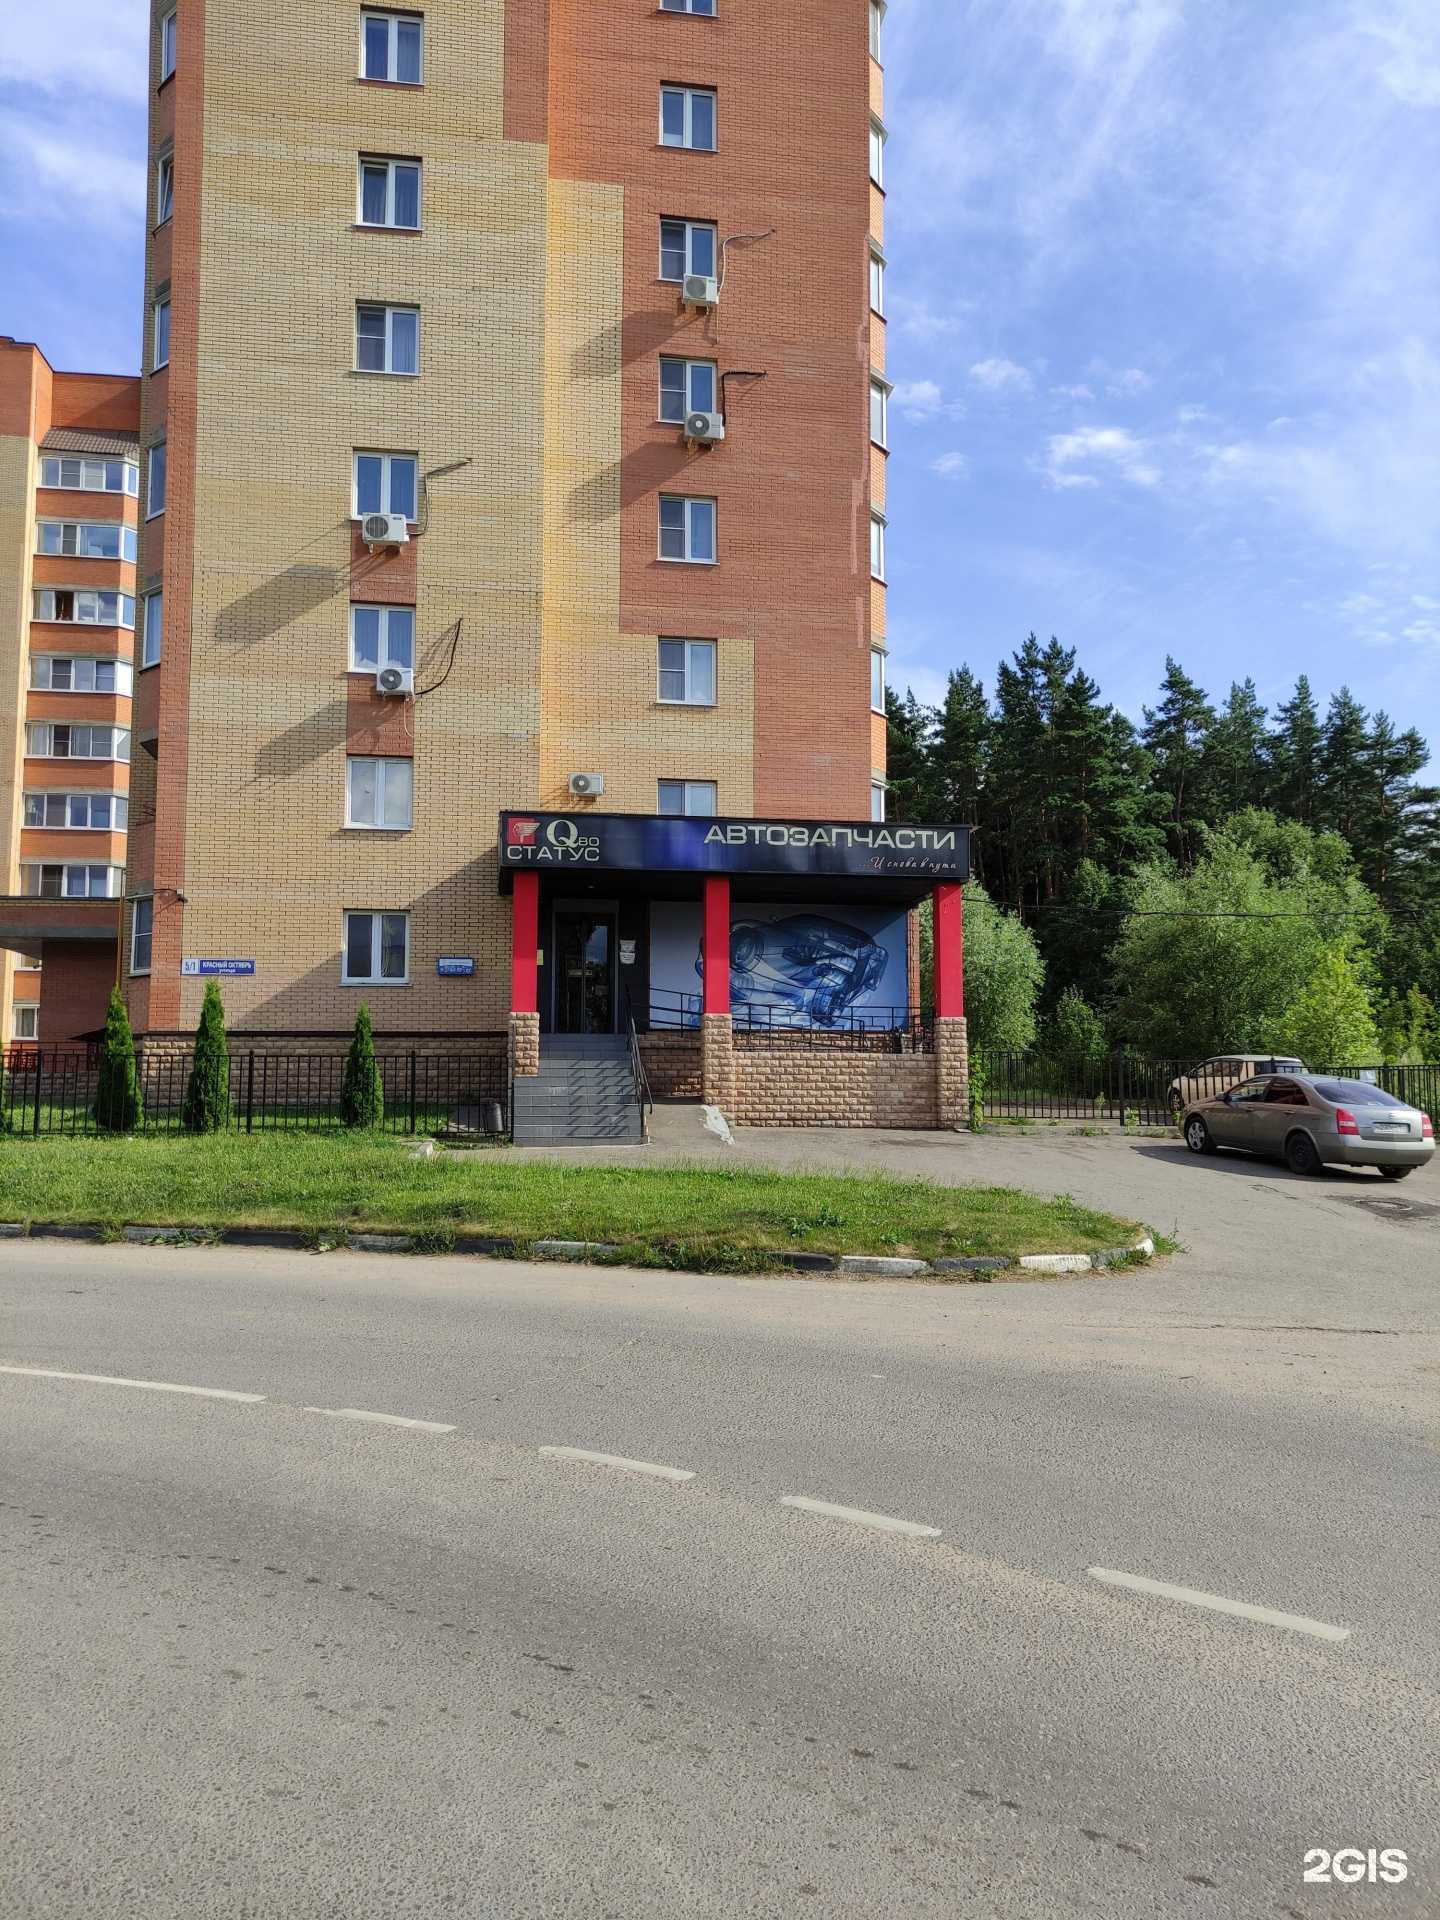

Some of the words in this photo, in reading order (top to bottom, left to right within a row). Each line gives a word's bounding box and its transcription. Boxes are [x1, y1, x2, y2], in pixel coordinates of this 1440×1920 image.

[703, 824, 956, 850] АВТОЗАПЧАСТИ
[507, 845, 600, 861] СТАТУС
[202, 960, 228, 969] КРАСНЫЙ
[228, 961, 252, 969] ОКТЯБРЬ
